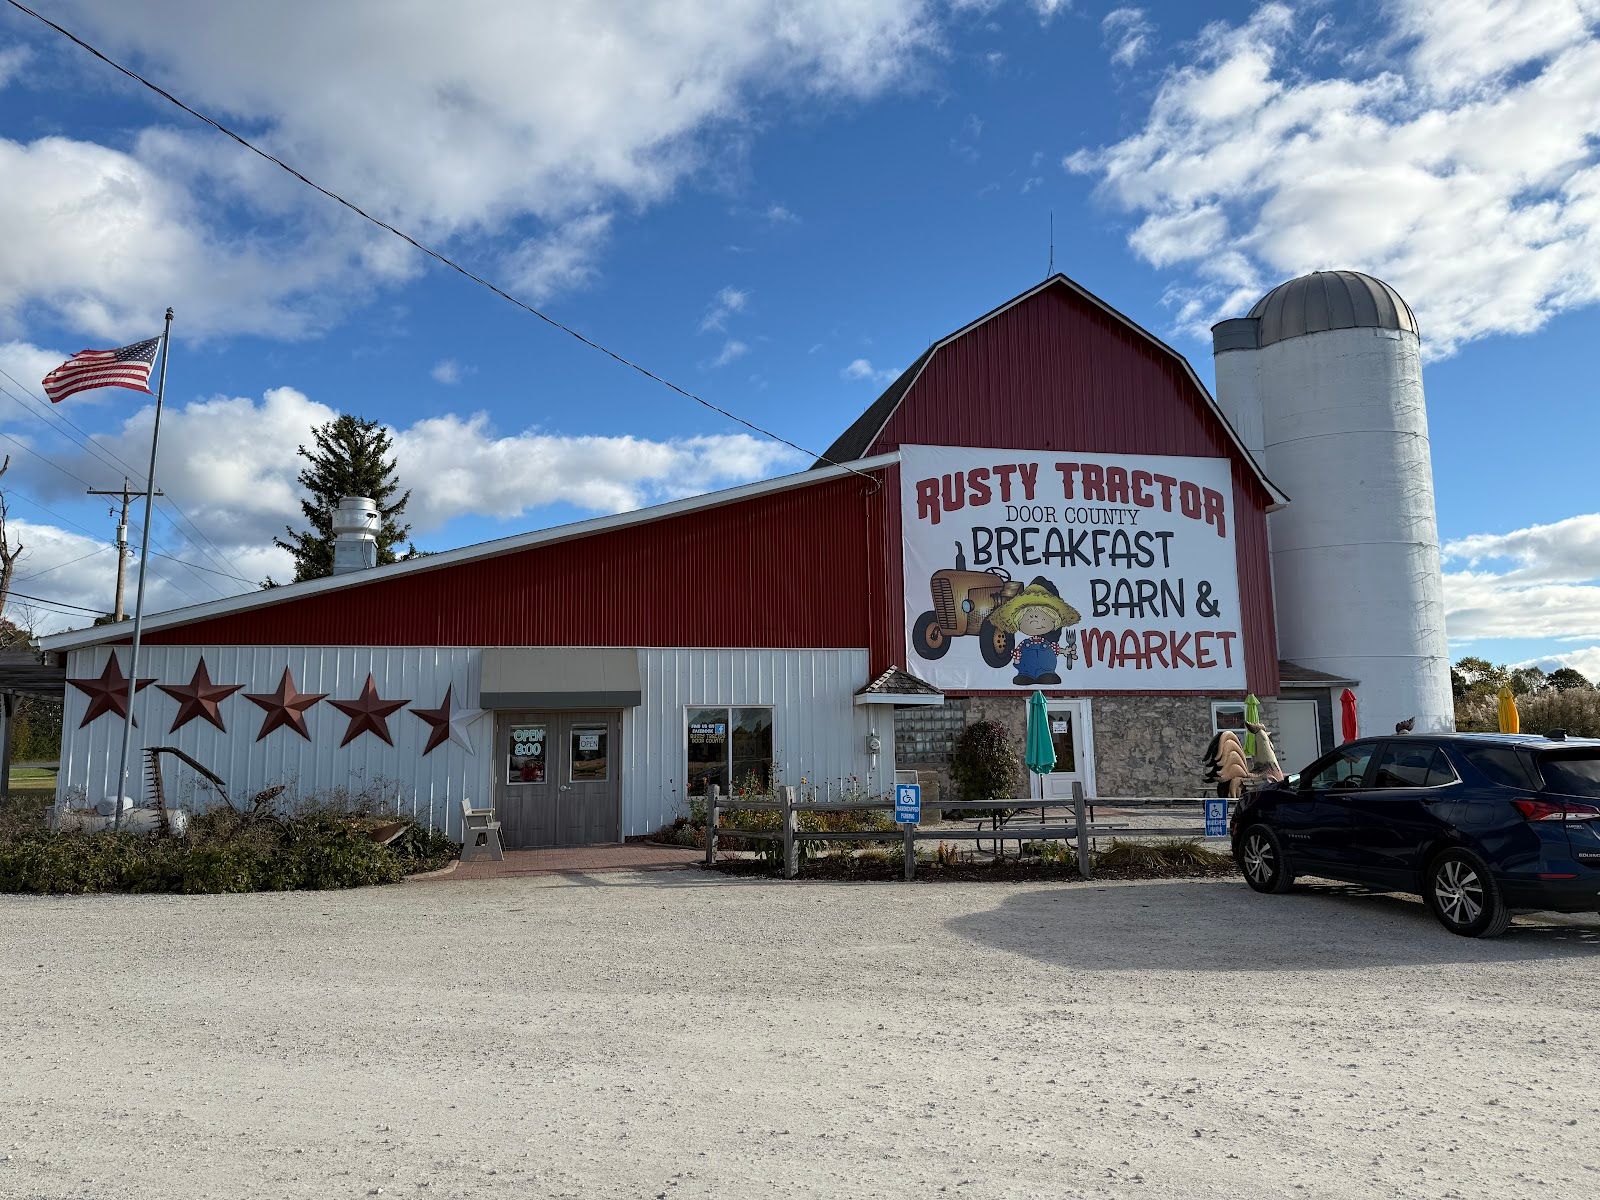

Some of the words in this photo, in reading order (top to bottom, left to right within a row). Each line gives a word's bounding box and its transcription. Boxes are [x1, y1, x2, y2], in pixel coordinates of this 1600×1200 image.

[916, 463, 1039, 526] RUSTY
[1054, 462, 1227, 538] TRACTOR
[1005, 505, 1058, 524] DOOR
[1064, 505, 1140, 526] COUNTY
[971, 526, 1175, 569] BREAKFAST
[1090, 577, 1185, 619] BARN
[1195, 580, 1221, 618] &
[1080, 627, 1237, 670] MARKET
[513, 730, 543, 742] OPEN
[515, 743, 541, 755] 8:00
[580, 740, 598, 748] OPEN
